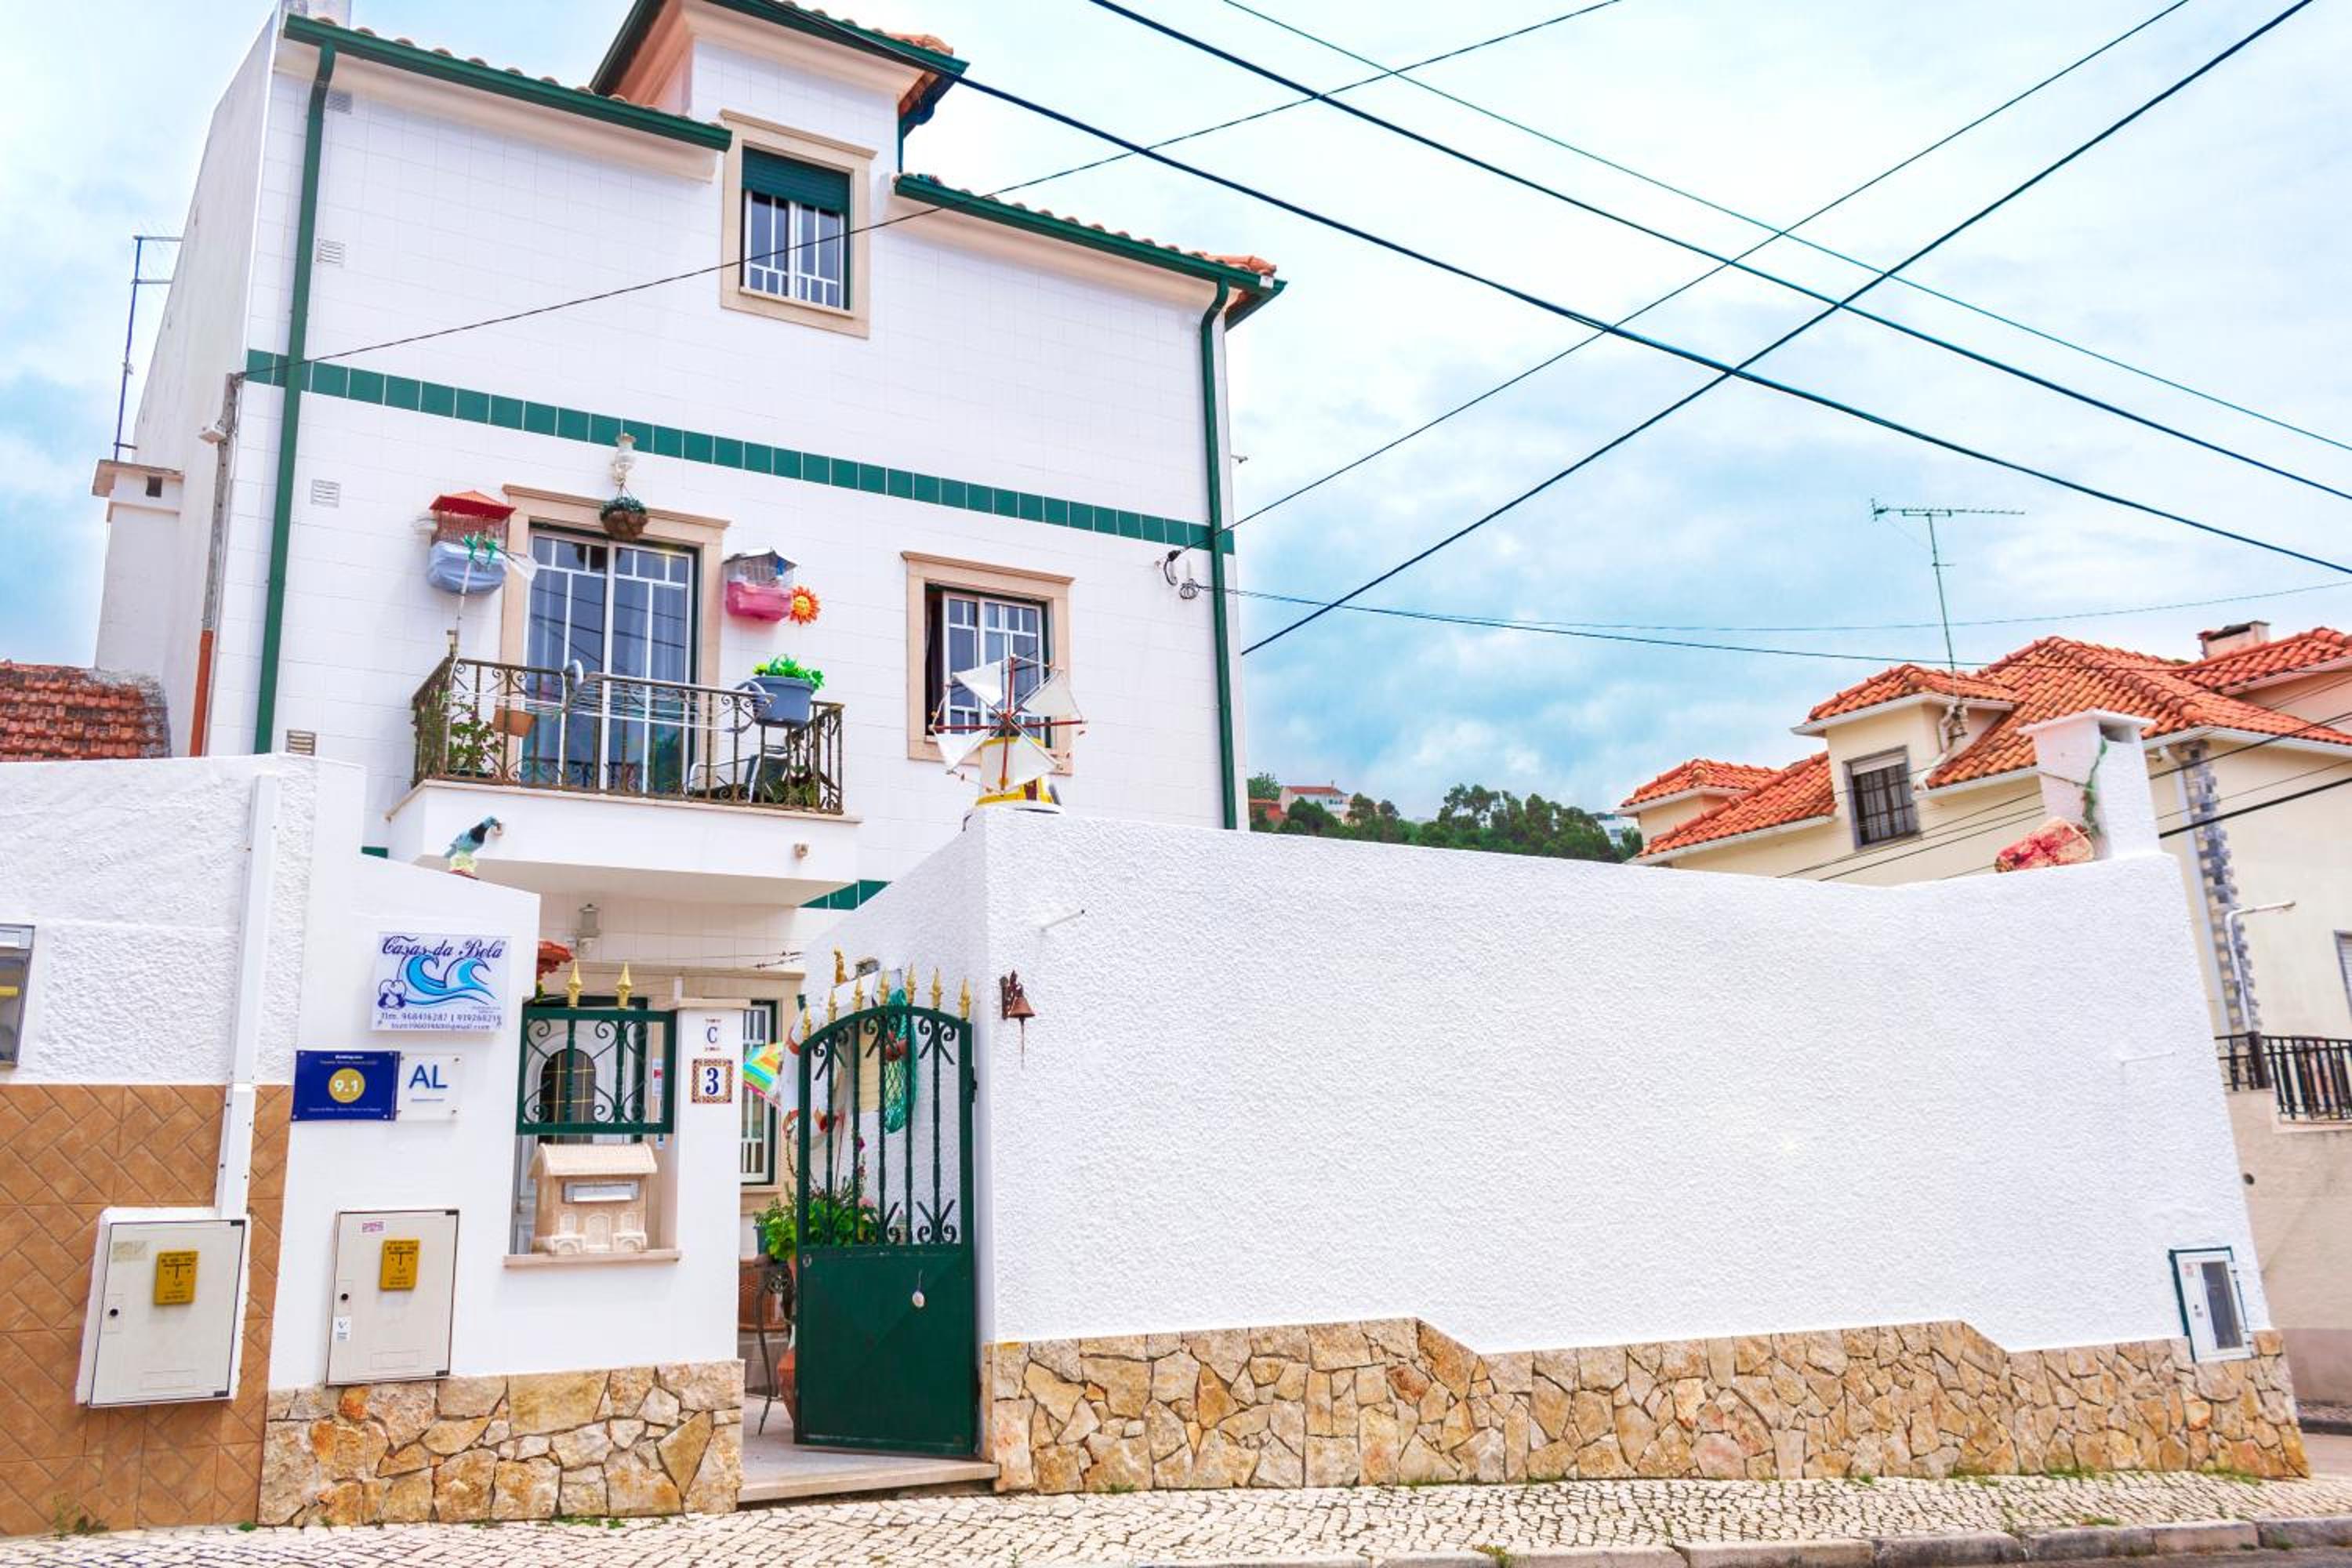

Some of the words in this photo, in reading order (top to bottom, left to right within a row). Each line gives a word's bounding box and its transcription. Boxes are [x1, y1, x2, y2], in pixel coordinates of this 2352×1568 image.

[432, 939, 453, 956] da
[706, 1026, 717, 1044] C
[334, 1079, 359, 1092] 9.1
[408, 1064, 448, 1089] AL
[706, 1067, 719, 1094] 3
